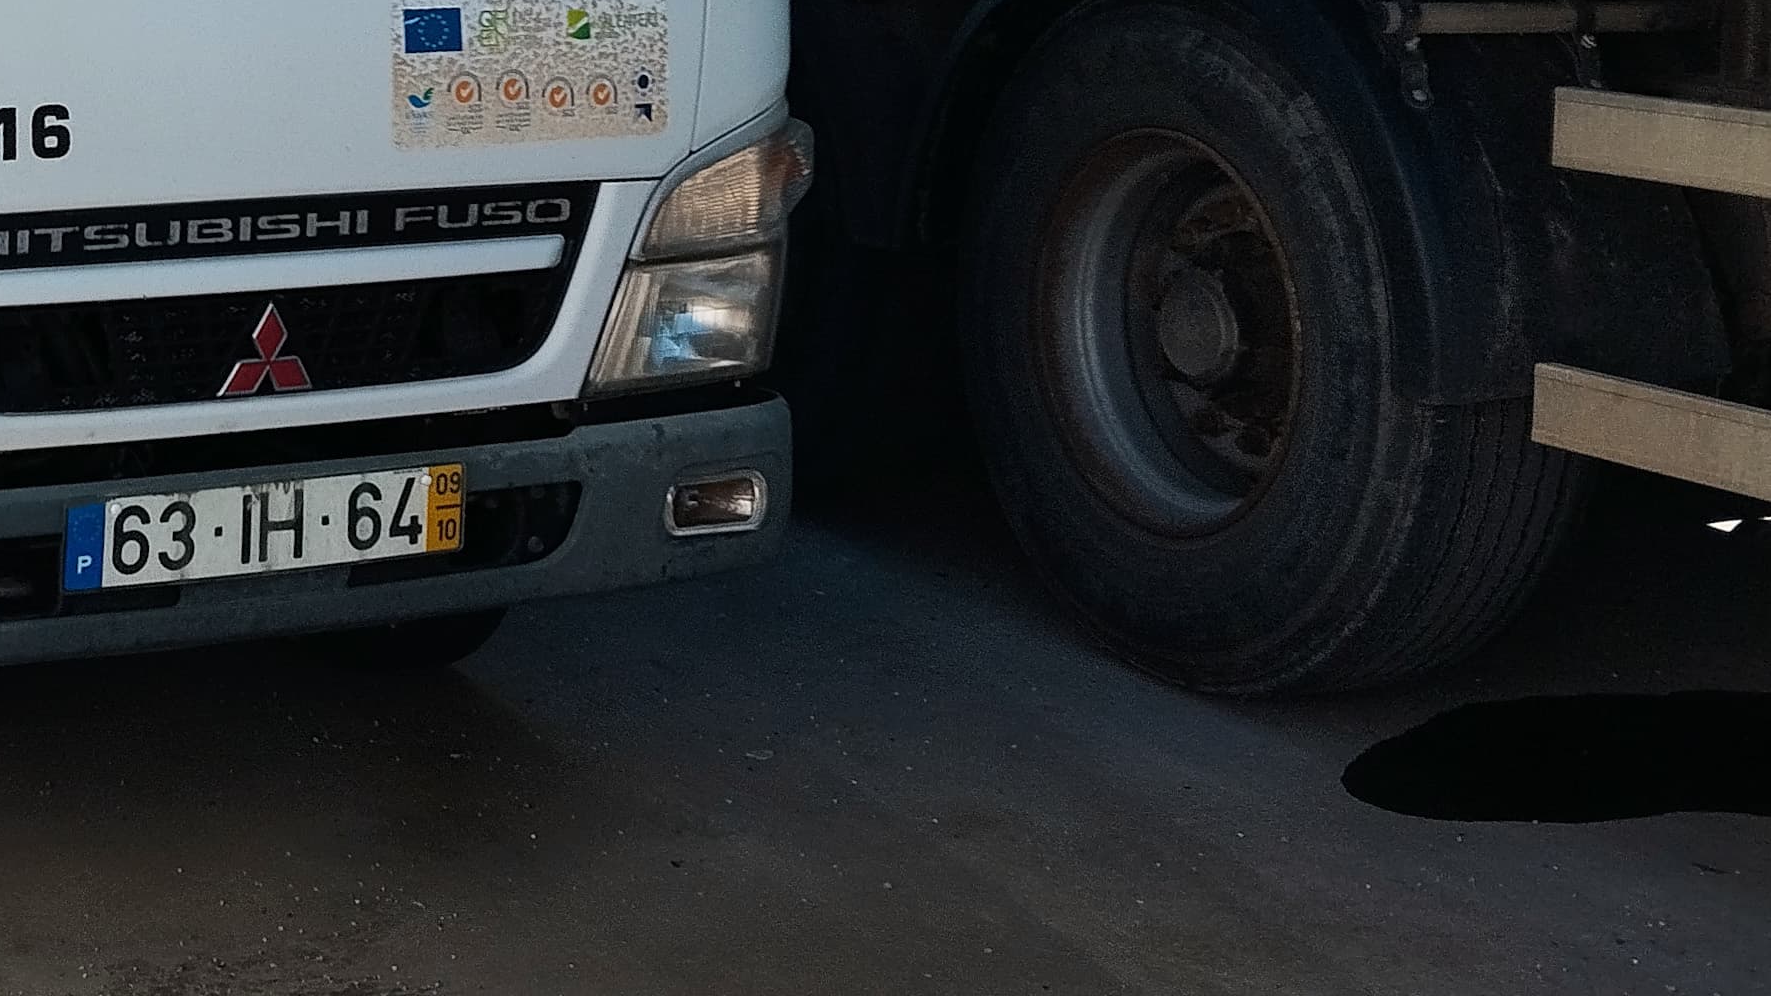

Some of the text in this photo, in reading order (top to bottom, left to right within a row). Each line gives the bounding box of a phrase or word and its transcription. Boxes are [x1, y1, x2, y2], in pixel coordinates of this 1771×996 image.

[394, 197, 573, 233] FUSO
[435, 471, 462, 495] 09
[436, 518, 458, 542] 10
[77, 554, 93, 575] P
